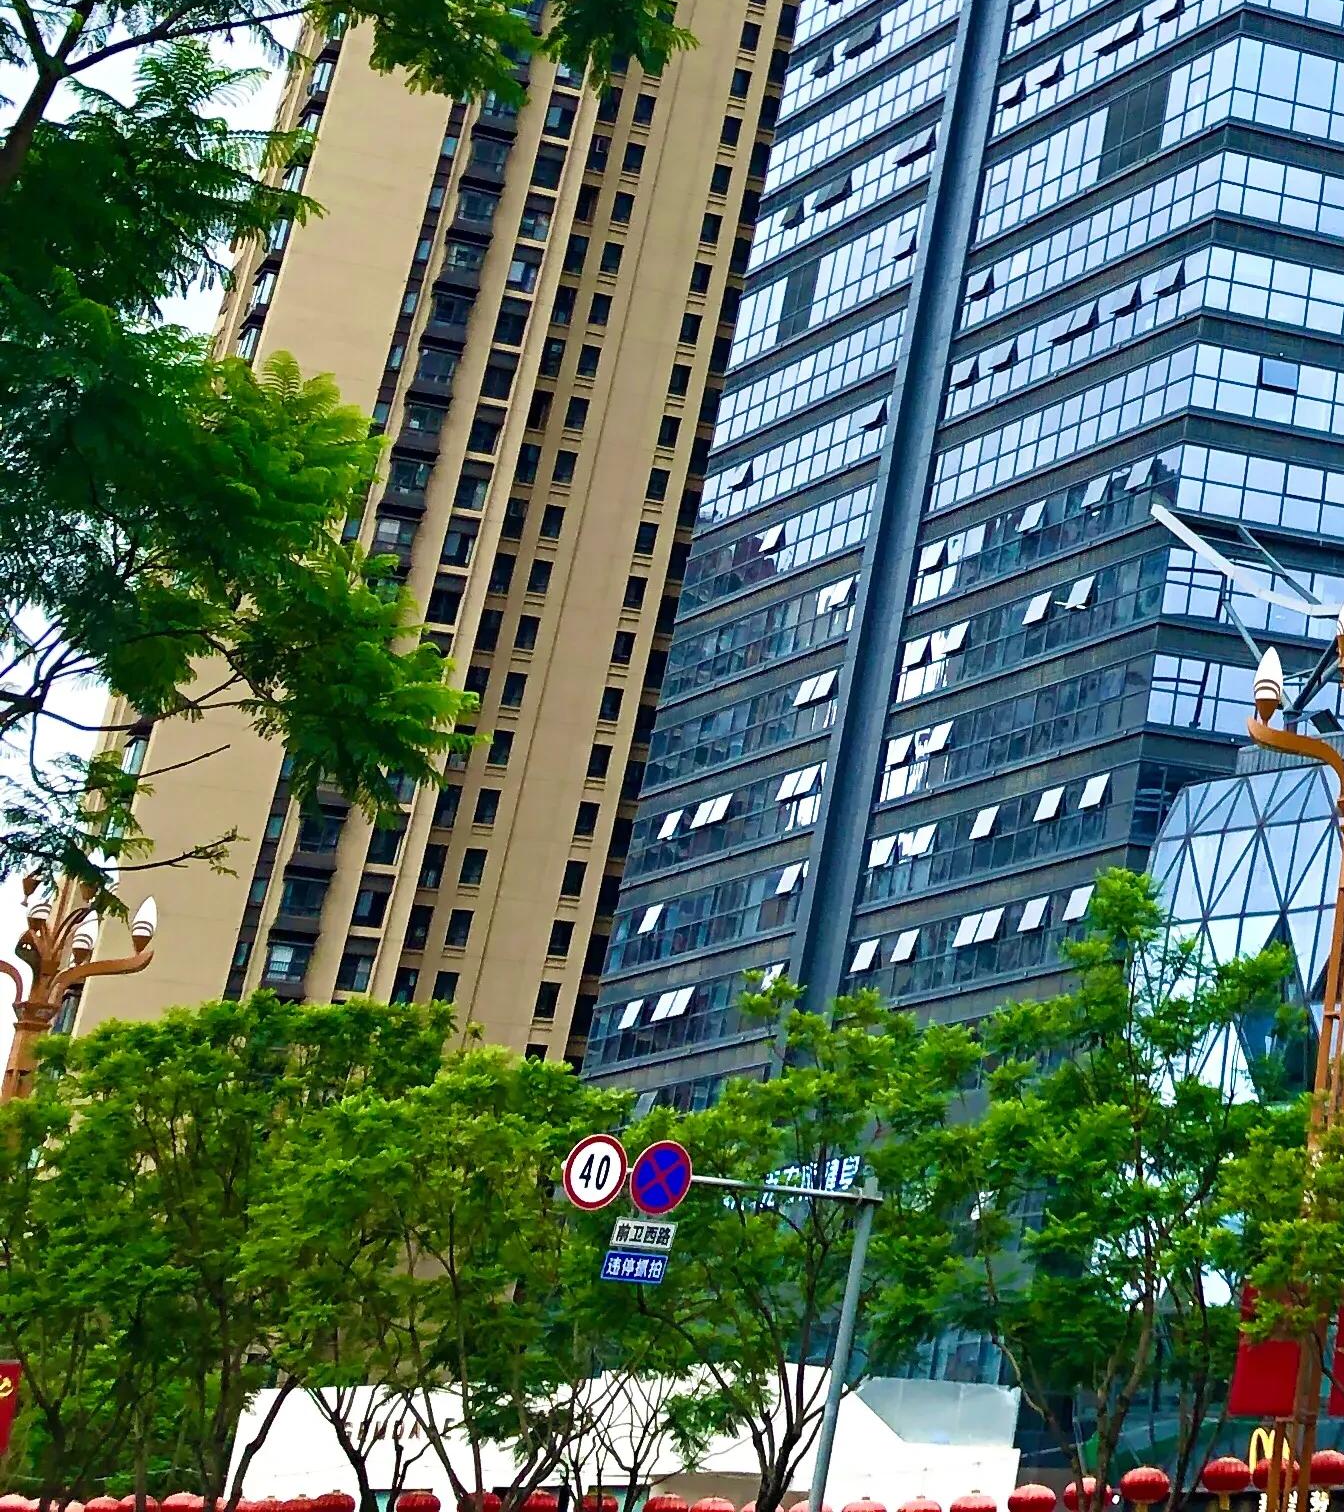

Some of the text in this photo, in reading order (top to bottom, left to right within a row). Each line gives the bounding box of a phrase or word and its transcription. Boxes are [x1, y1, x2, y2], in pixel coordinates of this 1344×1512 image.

[579, 1153, 611, 1190] 40
[616, 1223, 671, 1246] 前卫西路
